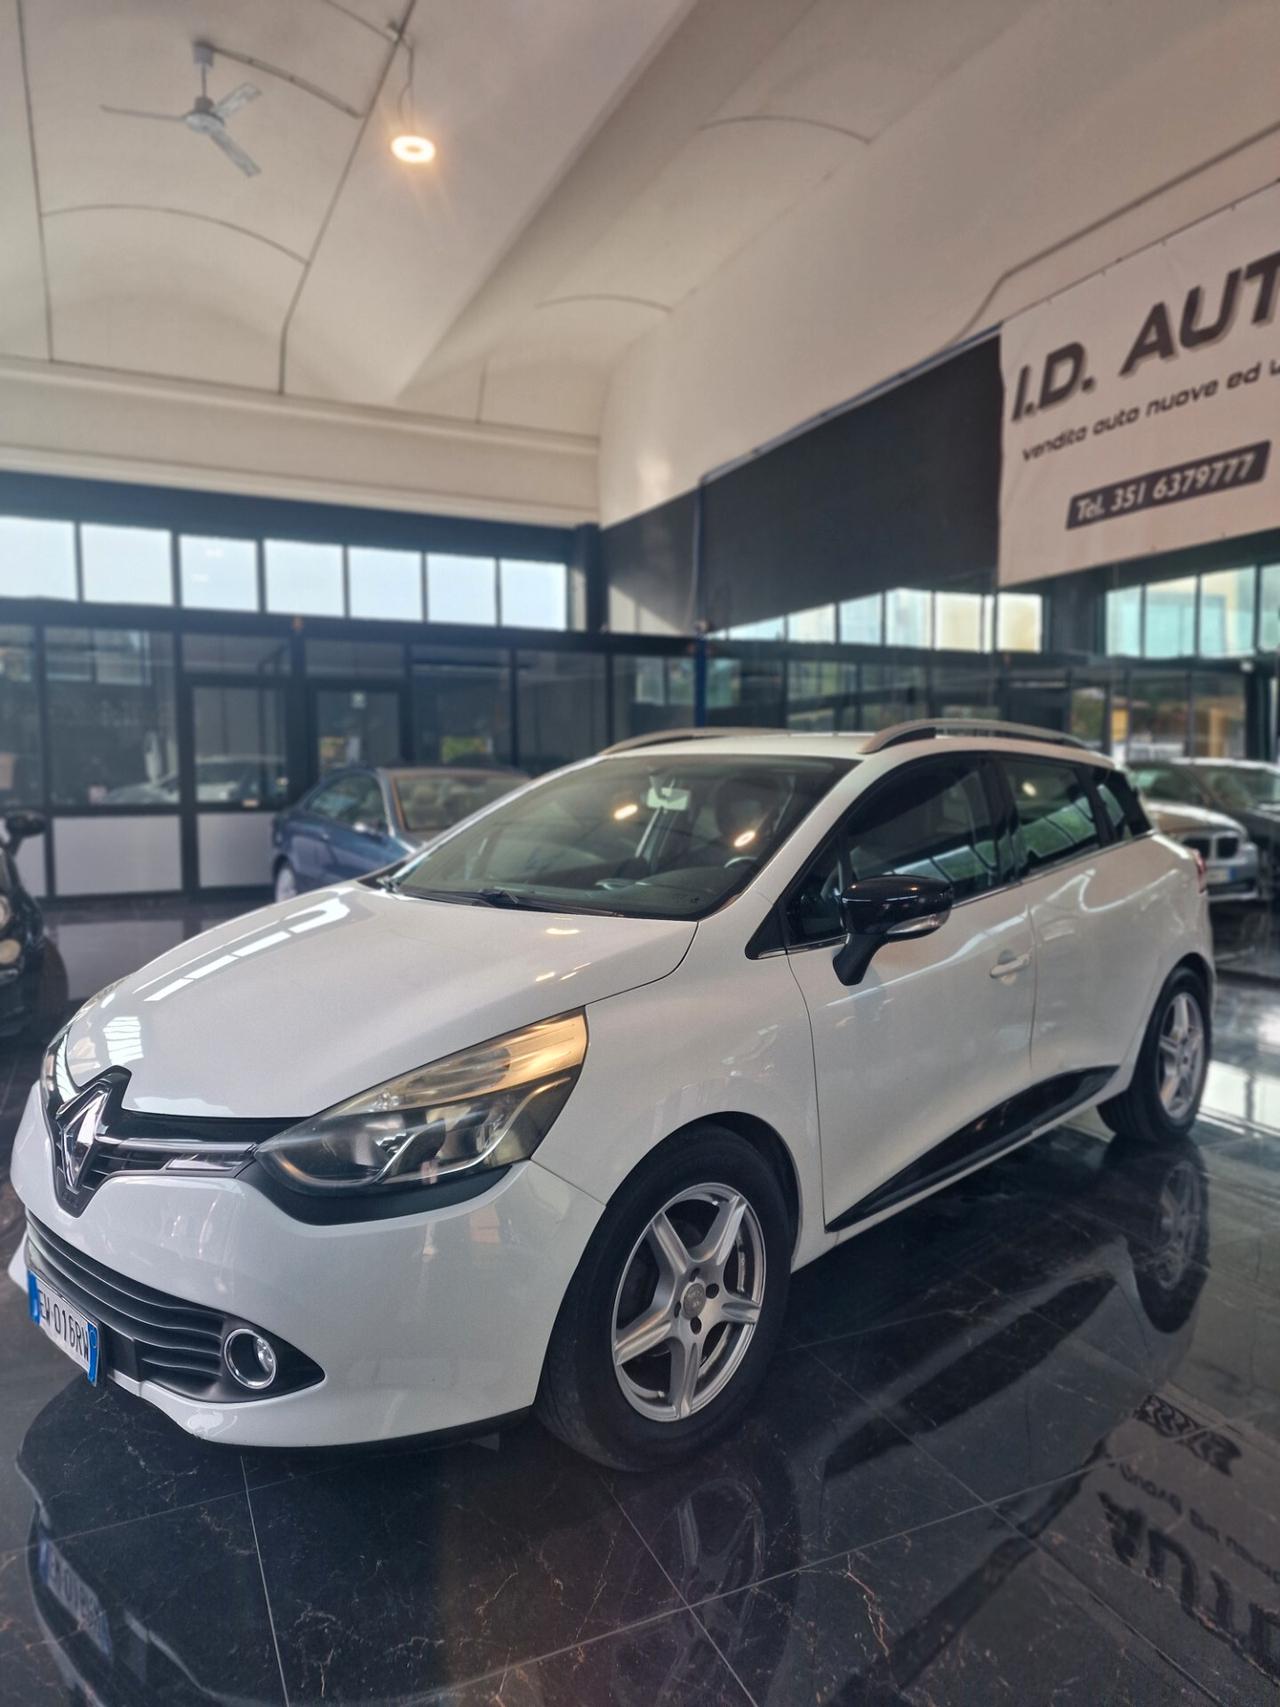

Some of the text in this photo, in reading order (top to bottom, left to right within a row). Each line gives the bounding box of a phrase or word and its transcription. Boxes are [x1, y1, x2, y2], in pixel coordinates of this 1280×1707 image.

[1011, 341, 1096, 422] I.D.
[1022, 425, 1088, 462] vendita
[1093, 406, 1140, 436] auto
[1146, 379, 1219, 418] nuove
[1227, 361, 1262, 390] ed
[1076, 452, 1256, 522] Tel. 351 6379777
